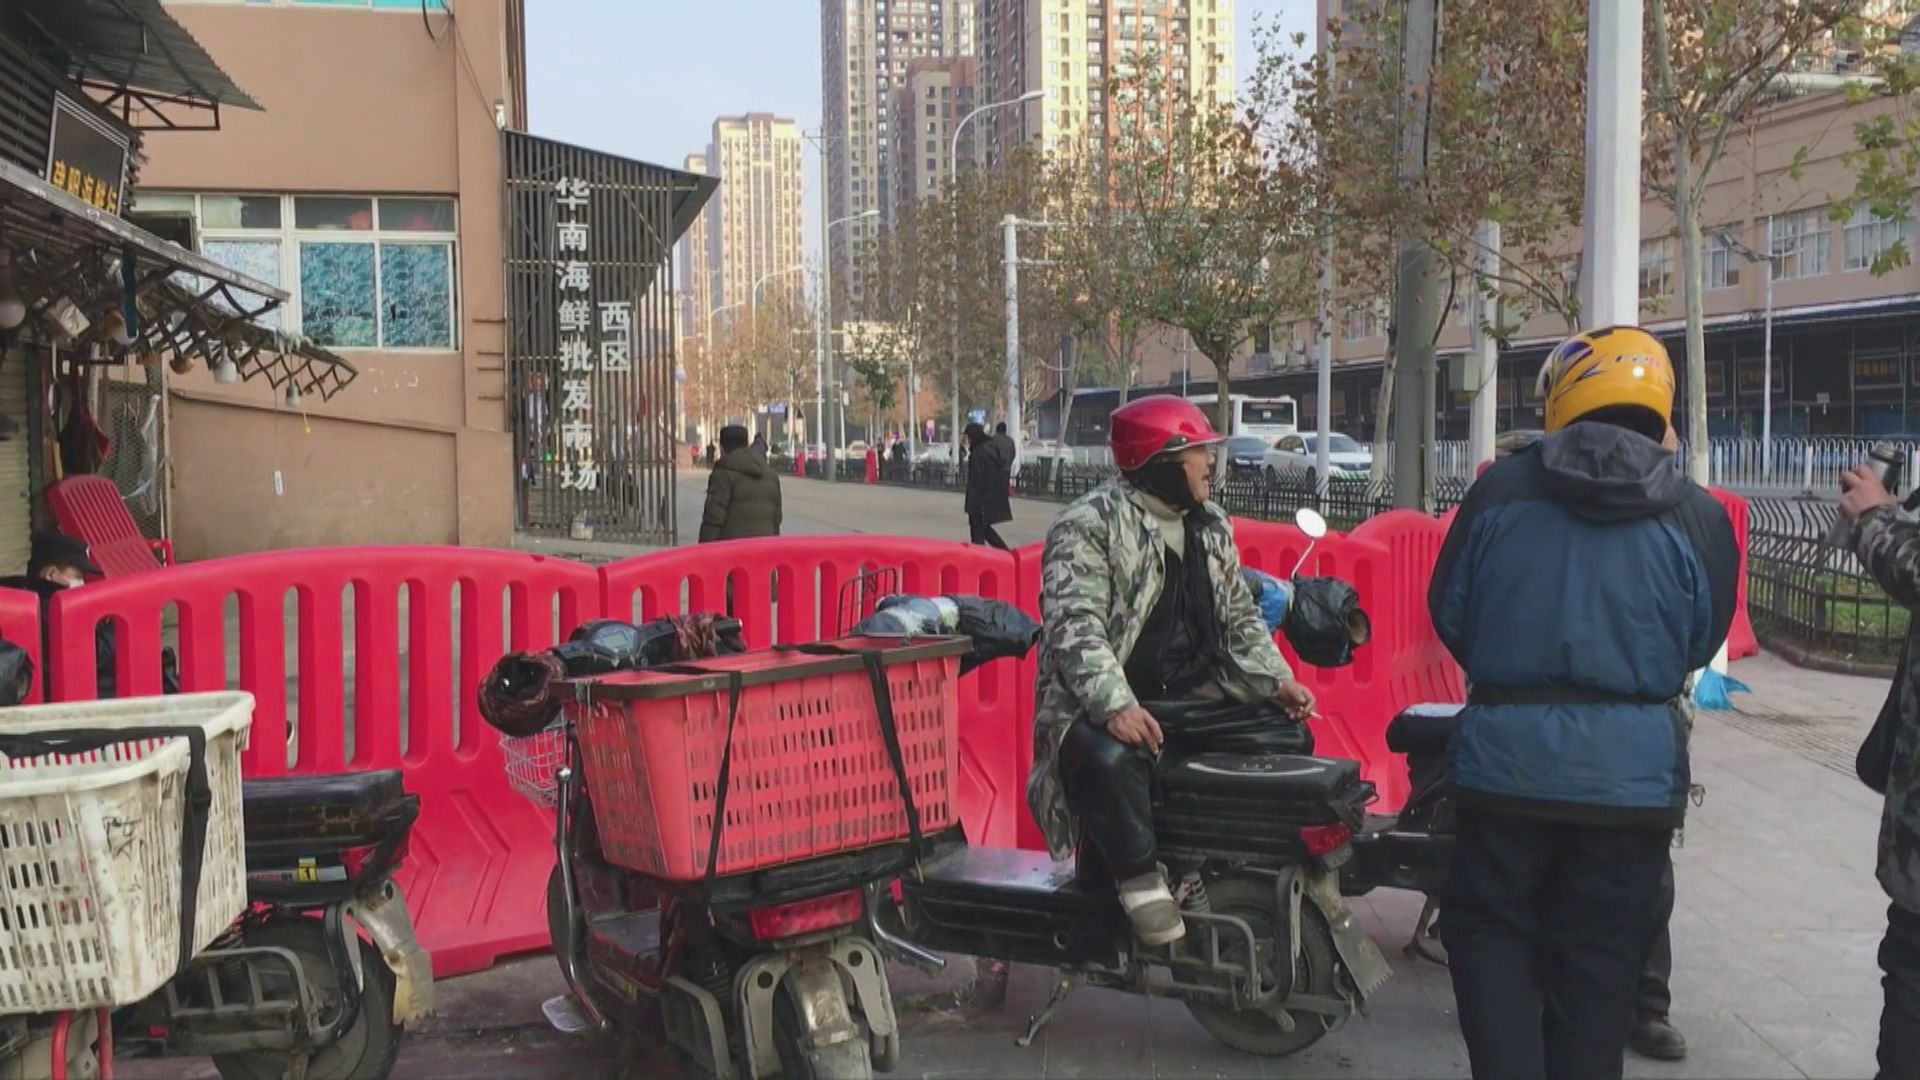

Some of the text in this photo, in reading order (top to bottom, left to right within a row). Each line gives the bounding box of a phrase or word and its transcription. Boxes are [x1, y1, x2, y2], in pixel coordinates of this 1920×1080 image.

[555, 176, 597, 491] 华南海鲜批发市场
[598, 302, 631, 371] 西区
